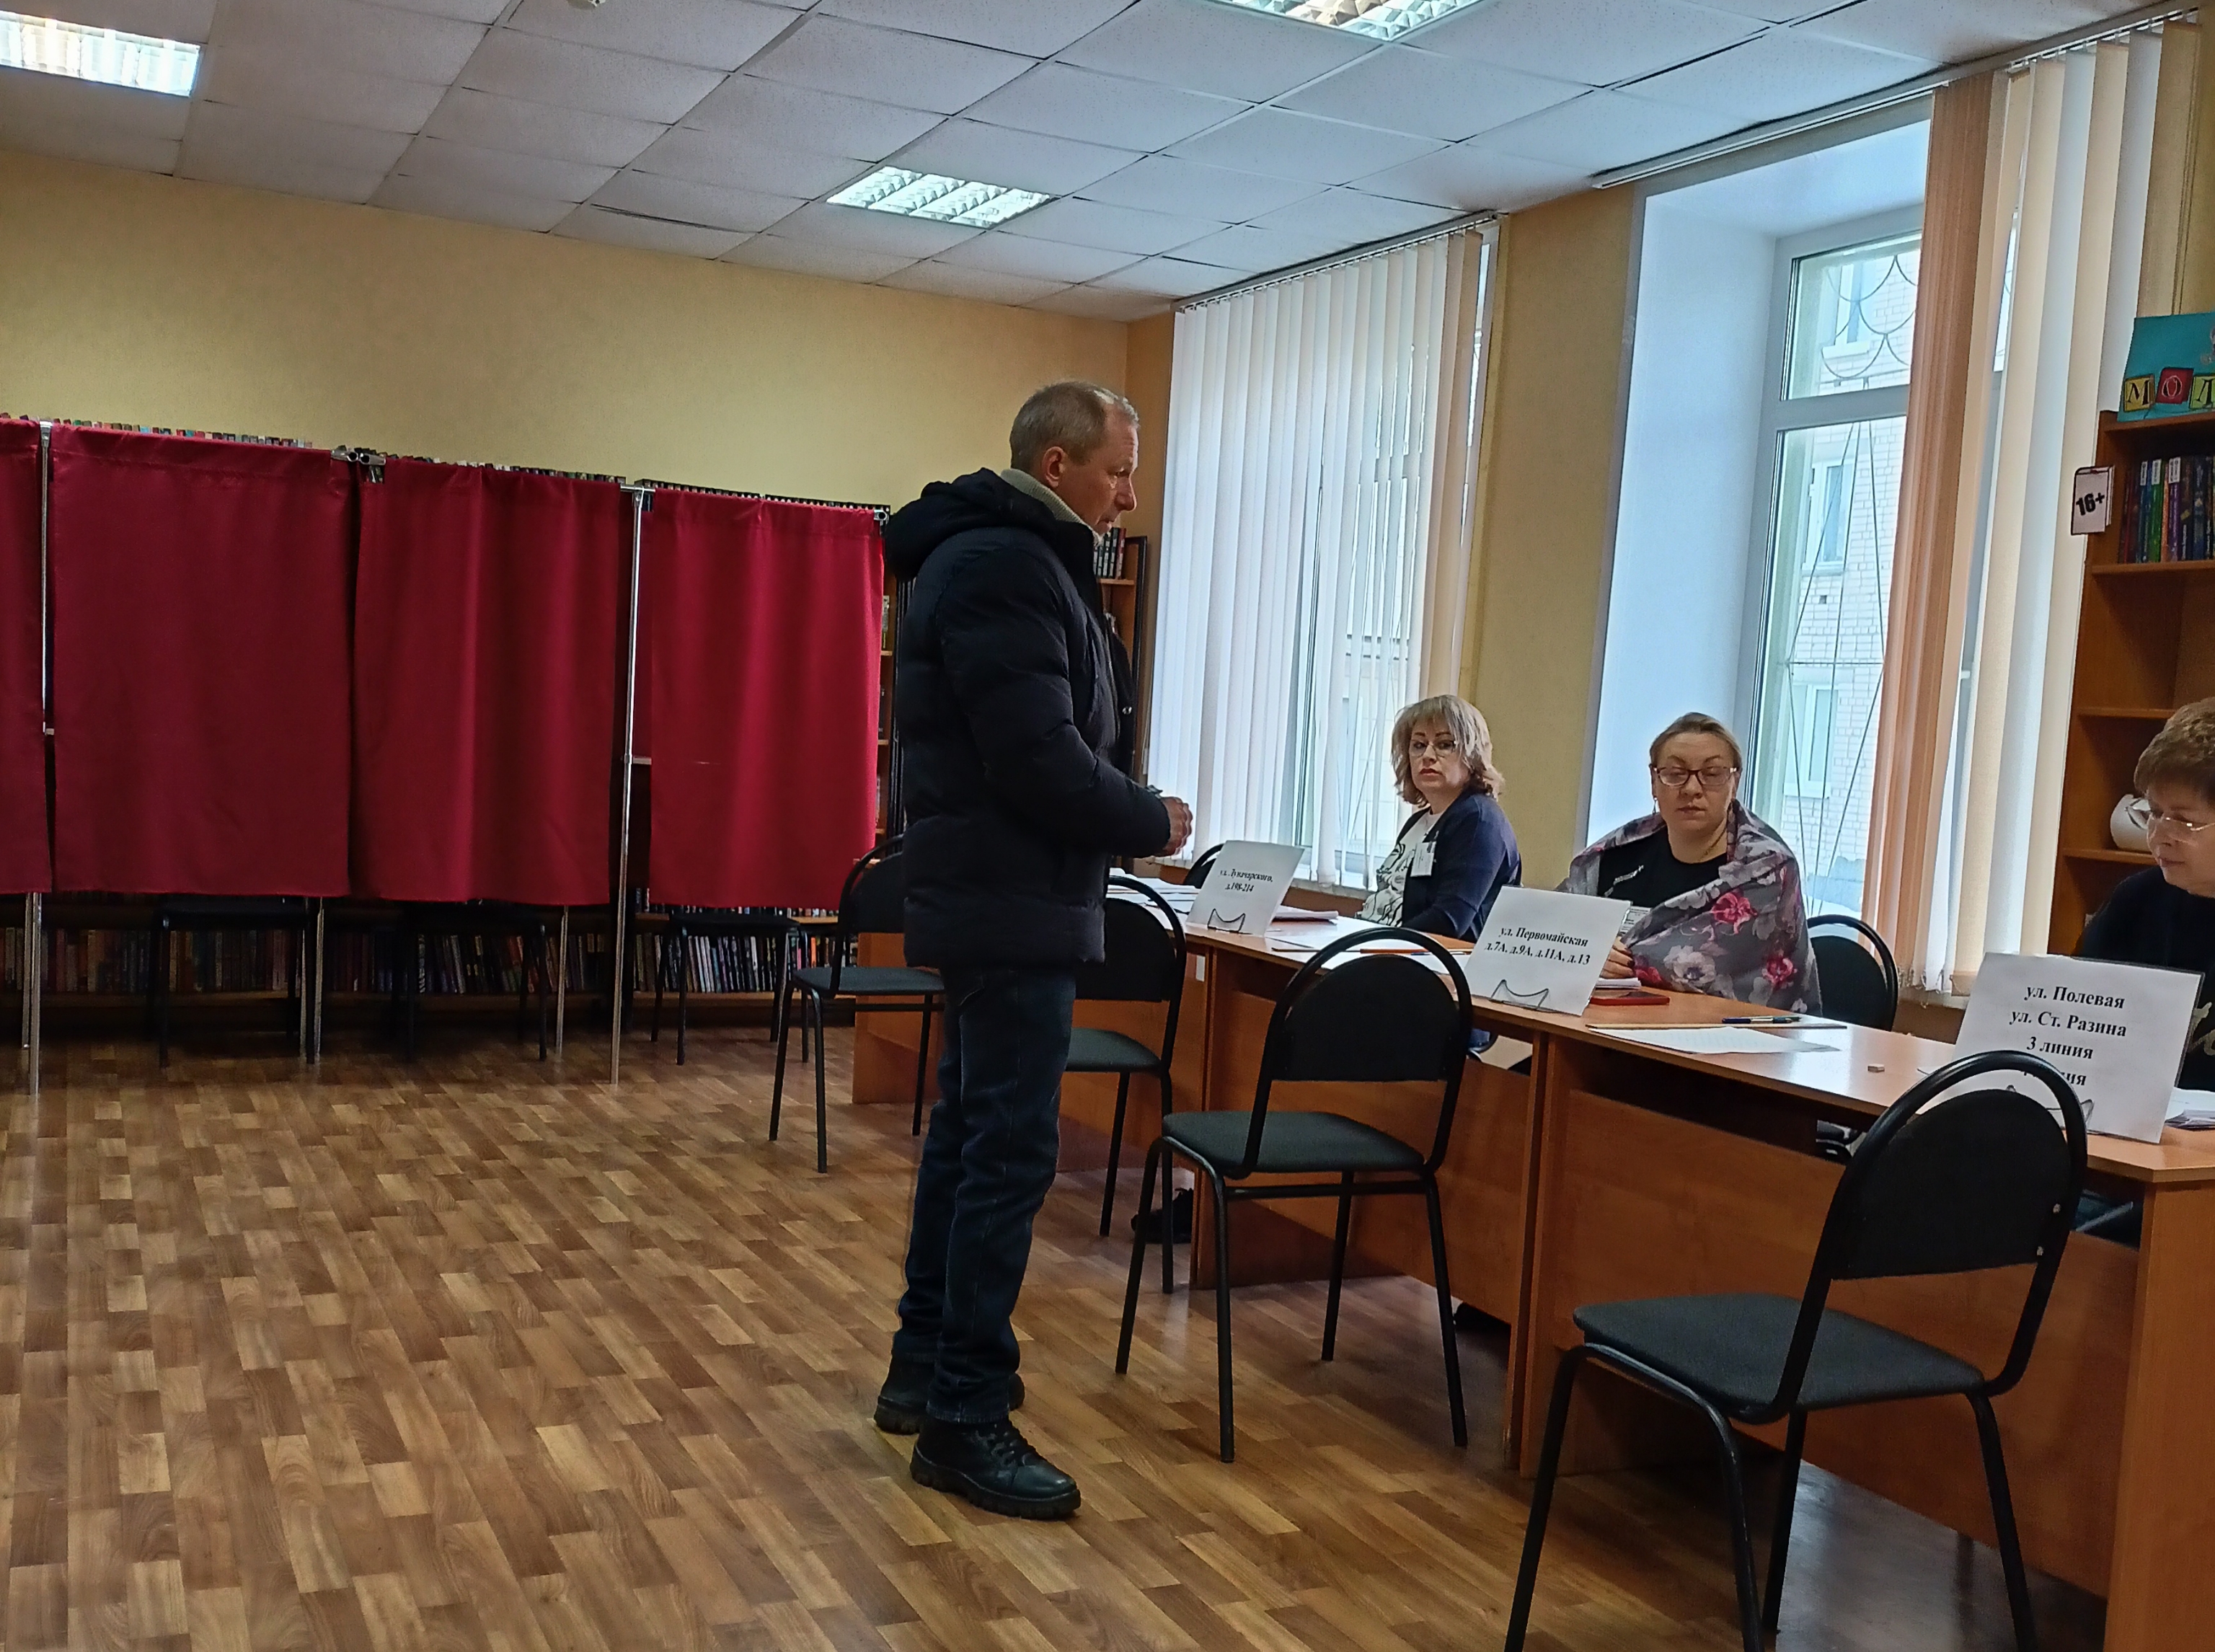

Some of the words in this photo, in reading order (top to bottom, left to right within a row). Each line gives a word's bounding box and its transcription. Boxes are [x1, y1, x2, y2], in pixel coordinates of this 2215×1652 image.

[2076, 492, 2106, 516] 16+
[1498, 927, 1513, 937] ул.
[1516, 927, 1588, 947] Первомайская
[1484, 941, 1508, 953] д.7А,
[1509, 945, 1533, 957] д.9А,
[1534, 948, 1565, 962] д.11А,
[1567, 954, 1591, 965] д.13
[2024, 986, 2047, 1001] ул.
[2053, 986, 2125, 1009] Полевая
[2009, 1010, 2032, 1025] ул.
[2038, 1010, 2061, 1028] Ст.
[2066, 1015, 2127, 1037] Разина
[2026, 1036, 2037, 1050] 3
[2039, 1042, 2093, 1059] линия
